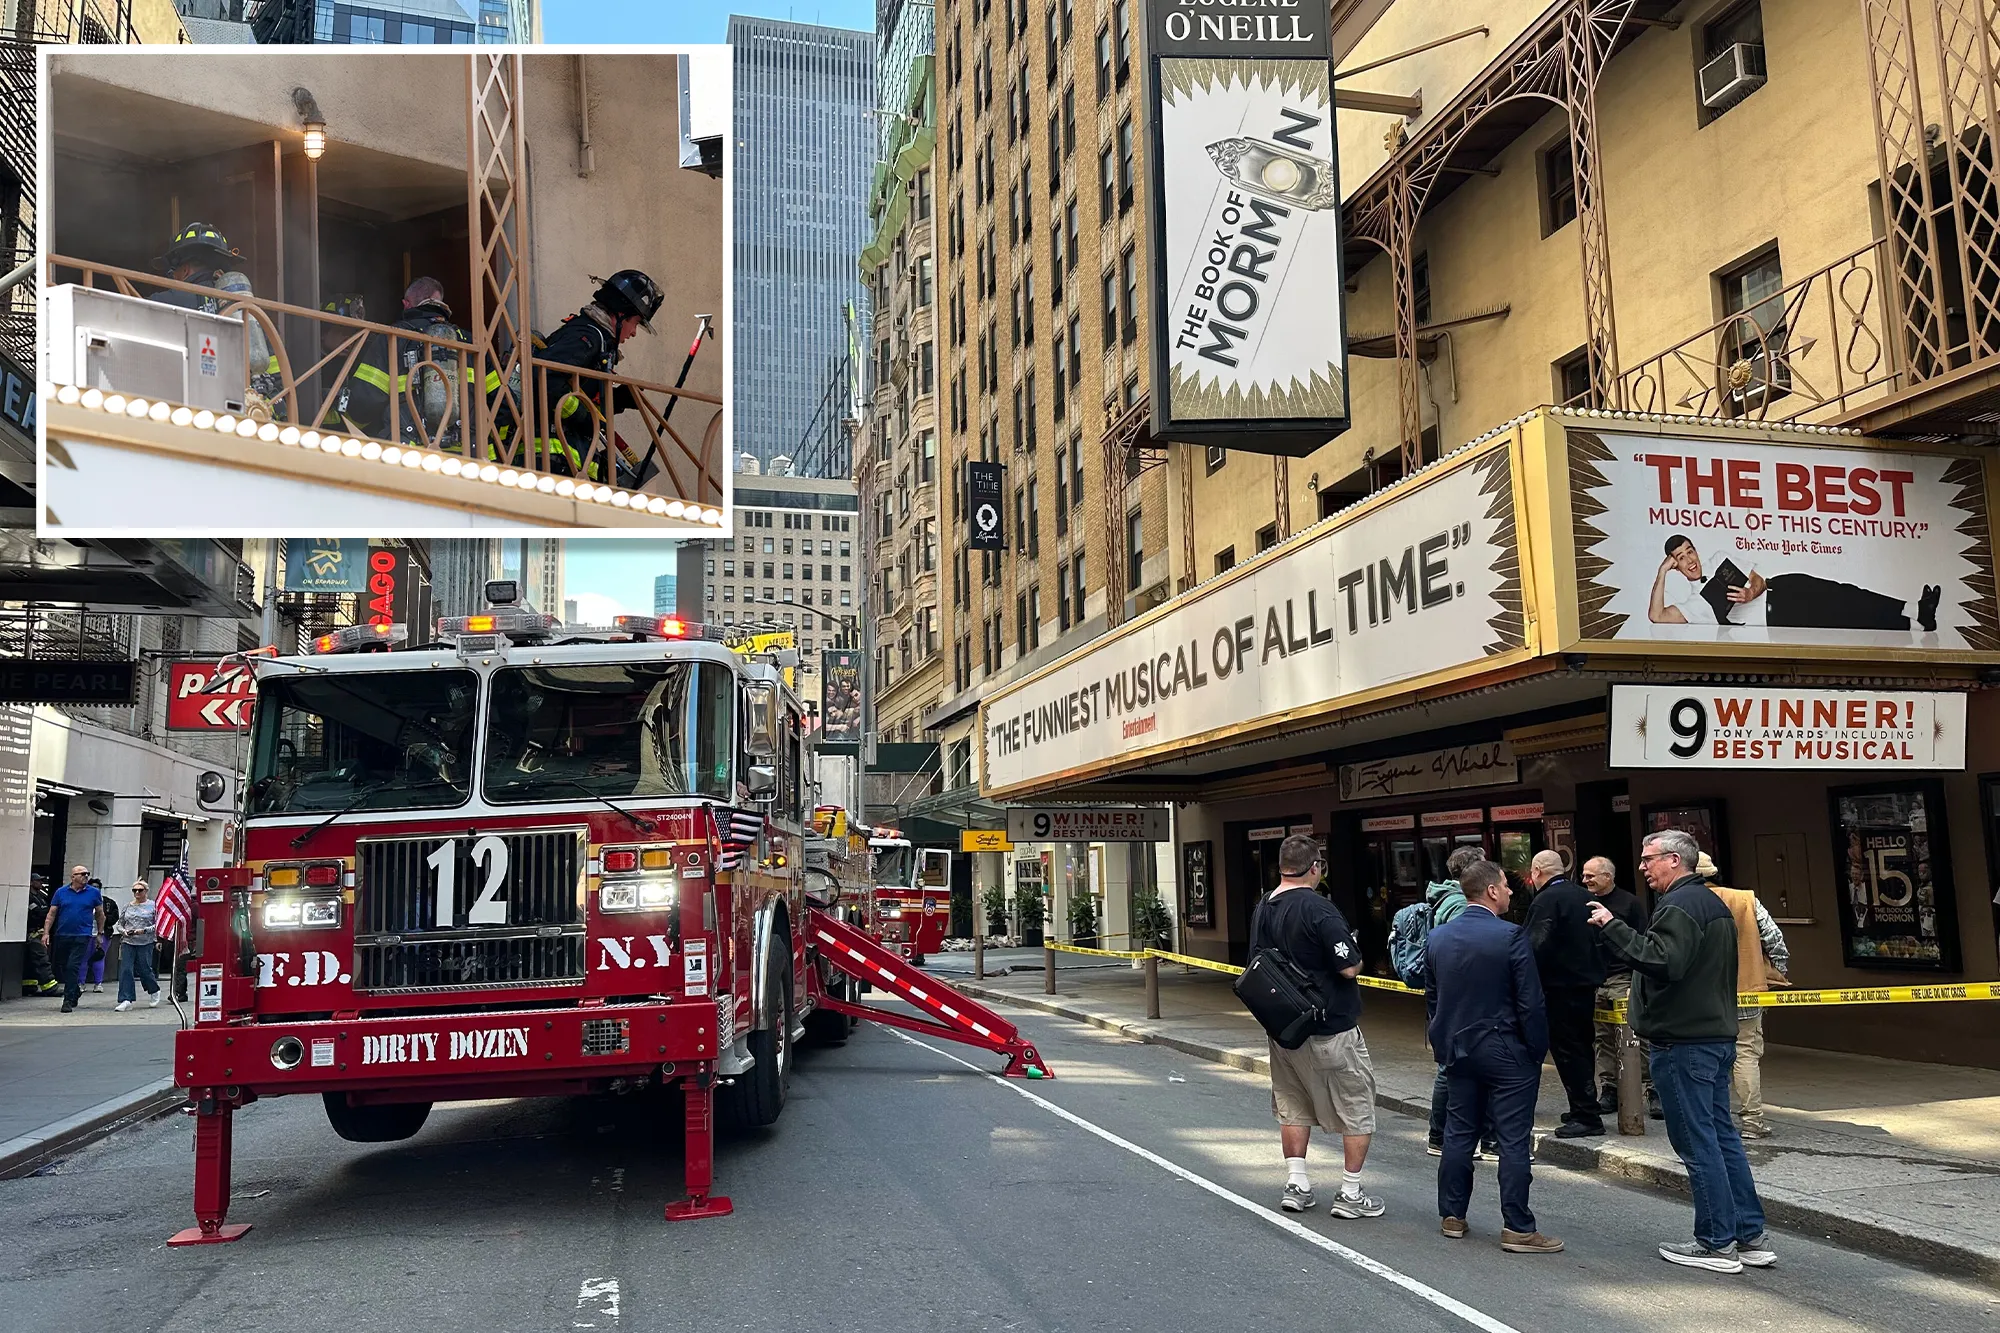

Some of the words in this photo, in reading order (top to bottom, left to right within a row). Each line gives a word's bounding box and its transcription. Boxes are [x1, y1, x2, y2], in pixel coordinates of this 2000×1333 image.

[1165, 9, 1314, 42] O'NEILL
[1176, 303, 1208, 351] THE
[1194, 229, 1235, 302] BOOK
[1221, 190, 1246, 226] OF
[974, 471, 993, 481] THE
[1775, 462, 1914, 518] BEST
[1649, 507, 1740, 530] MUSICAL
[1744, 513, 1772, 531] OF
[1778, 515, 1822, 534] THIS
[1735, 536, 1757, 551] The
[1757, 537, 1779, 551] New
[1782, 539, 1808, 556] York
[1811, 541, 1843, 554] Times
[1023, 681, 1101, 748] FUNNIEST
[1106, 639, 1208, 719] MUSICAL
[1212, 614, 1254, 681] OF
[1262, 587, 1334, 666] ALL
[34, 674, 125, 691] PEARL
[1713, 698, 1914, 728] WINNER!
[1668, 696, 1709, 760] 9
[1713, 729, 1752, 738] TONY
[1835, 731, 1914, 740] INCLUDING
[1713, 740, 1782, 759] BEST
[1794, 740, 1914, 760] MUSICAL
[1033, 813, 1051, 838] 9
[1053, 813, 1145, 825] WINNER!
[1548, 819, 1570, 828] HELLO
[1053, 830, 1085, 838] BEST
[1090, 830, 1145, 838] MUSICAL
[1866, 836, 1907, 848] HELLO
[426, 836, 510, 928] 12
[1863, 848, 1912, 906] 15
[1875, 913, 1915, 922] MORMON
[256, 951, 351, 988] F.D.
[1911, 988, 1922, 999] FIRE
[1933, 987, 1941, 998] DO
[1941, 987, 1950, 998] NOT
[1951, 986, 1967, 998] CROSS
[362, 1032, 440, 1065] DIRTY
[448, 1027, 530, 1060] DOZEN
